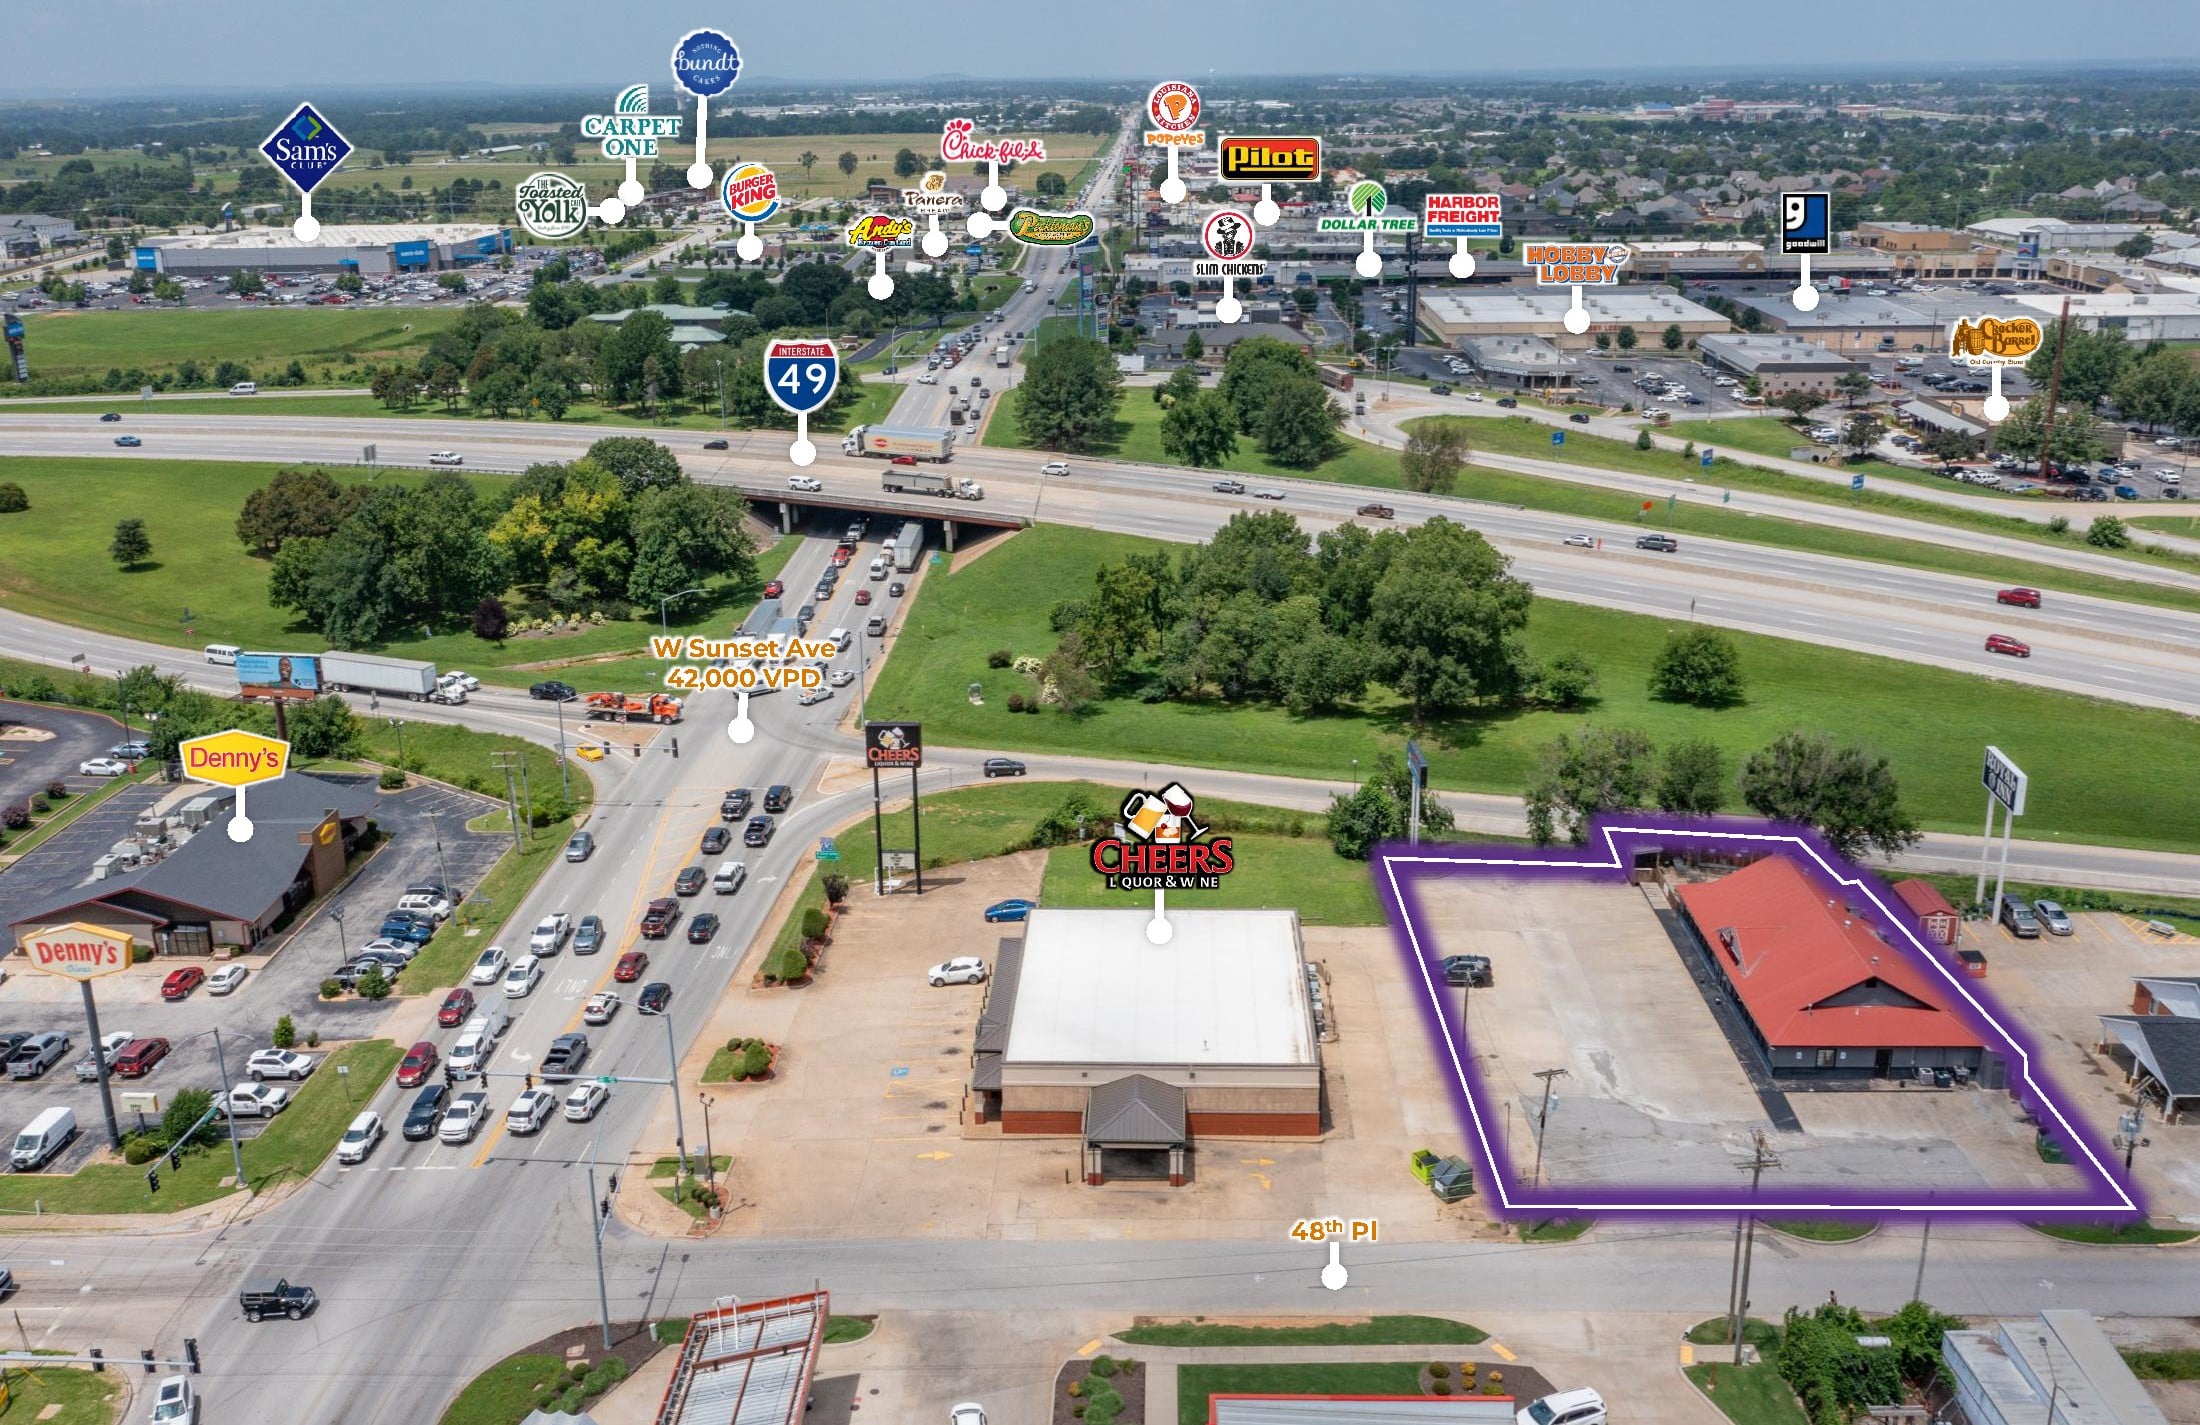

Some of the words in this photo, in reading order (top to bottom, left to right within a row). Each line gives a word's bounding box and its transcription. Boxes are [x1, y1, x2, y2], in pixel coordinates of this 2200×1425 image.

[868, 747, 919, 761] CHEERS
[1986, 750, 2017, 791] ROYAL
[1995, 777, 2013, 805] INN
[35, 941, 117, 966] Denny's
